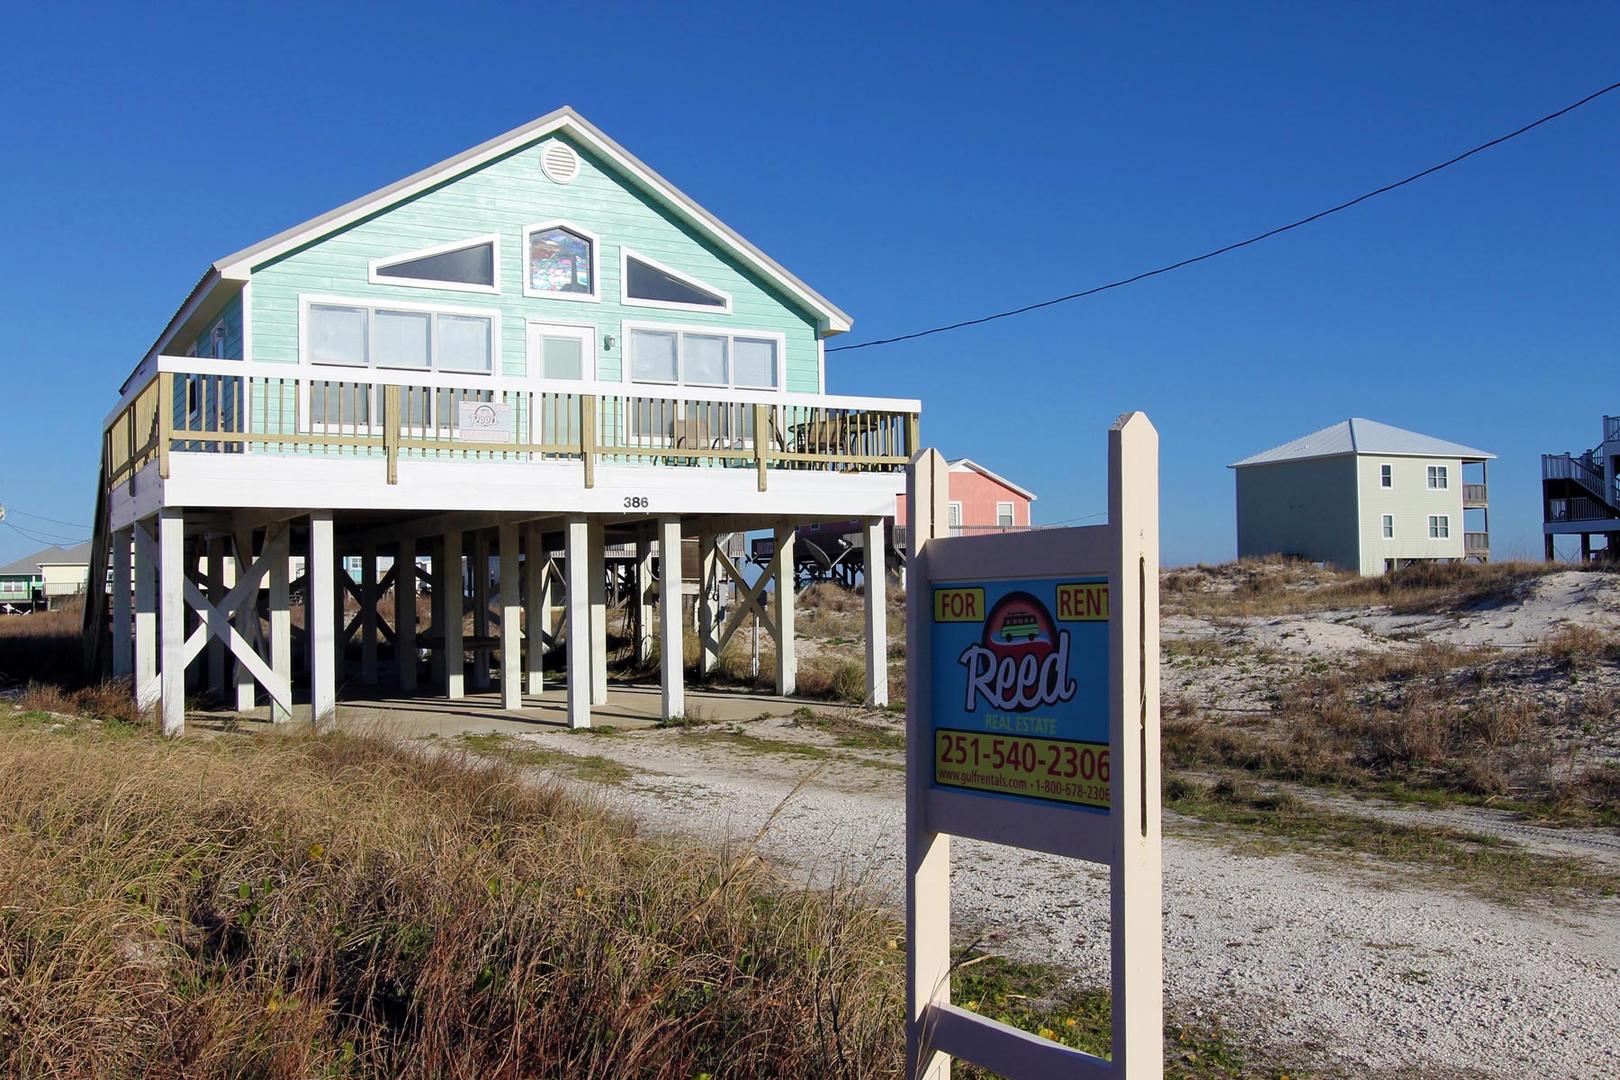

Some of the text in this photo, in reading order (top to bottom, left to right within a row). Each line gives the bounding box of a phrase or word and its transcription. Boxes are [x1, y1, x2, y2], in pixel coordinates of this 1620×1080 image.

[623, 496, 649, 508] 386
[941, 592, 976, 618] FOR
[959, 630, 1076, 712] Reed
[984, 713, 1057, 735] REAL ESTATE
[940, 734, 1109, 783] 251-540-2306
[938, 769, 1027, 790] www.gulfrentals.com
